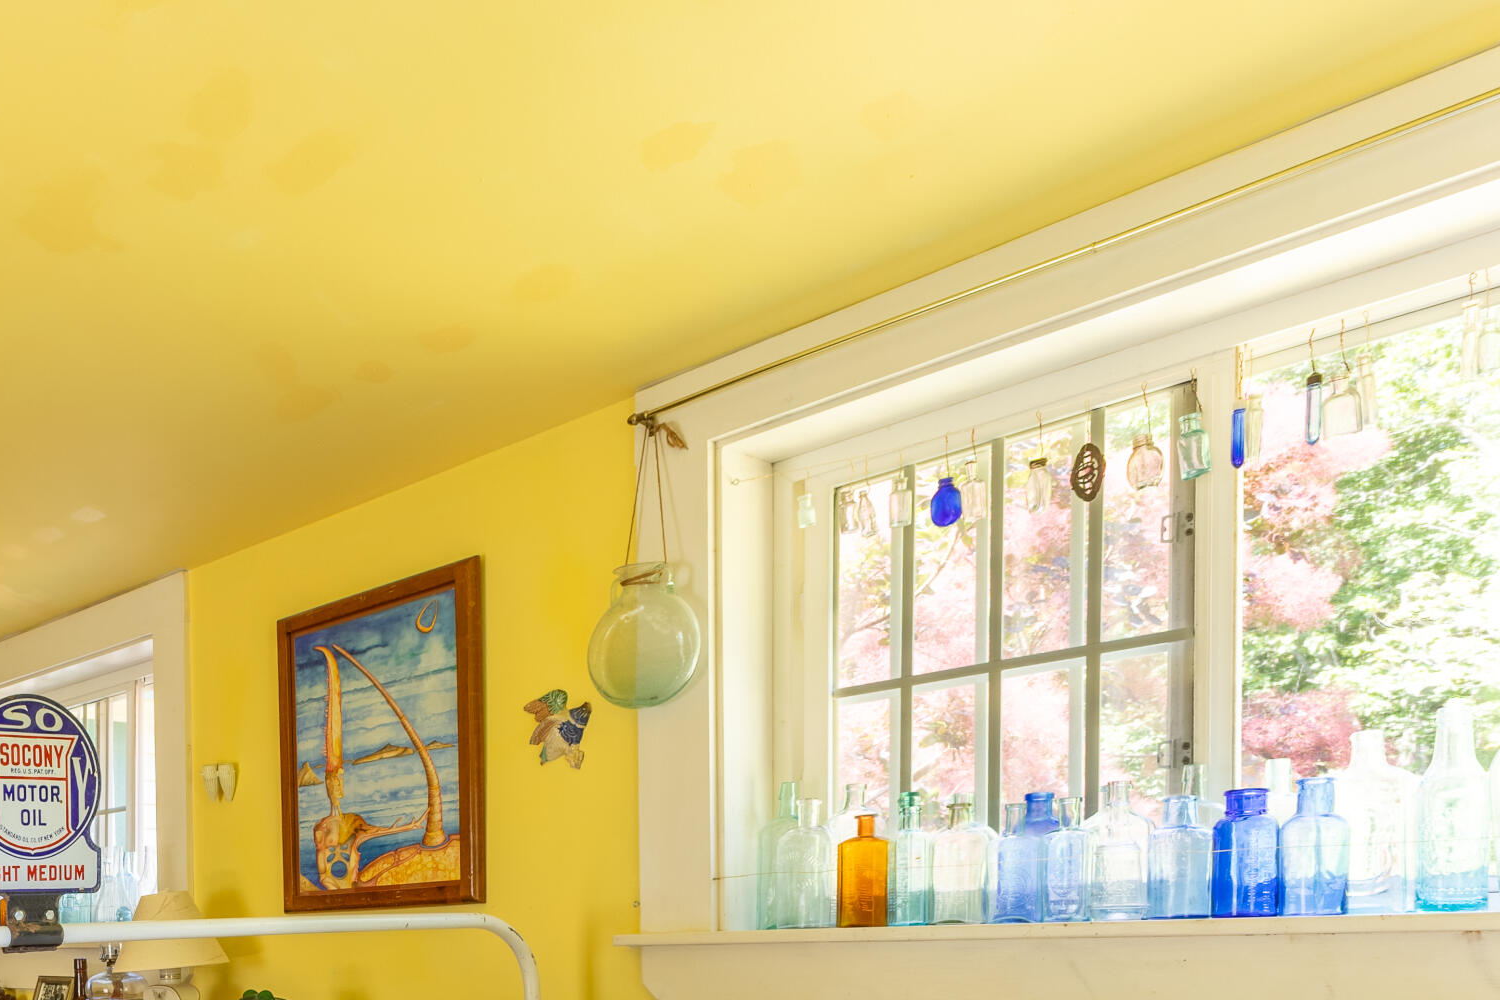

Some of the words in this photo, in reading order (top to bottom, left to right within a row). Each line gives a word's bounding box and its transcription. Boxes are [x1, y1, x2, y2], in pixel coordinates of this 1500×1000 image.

[0, 743, 64, 768] SOCONY
[3, 784, 61, 803] MOTOR
[20, 809, 47, 827] OIL
[0, 824, 22, 841] STANDARD
[54, 826, 65, 837] YORK
[27, 864, 85, 882] MEDIUM
